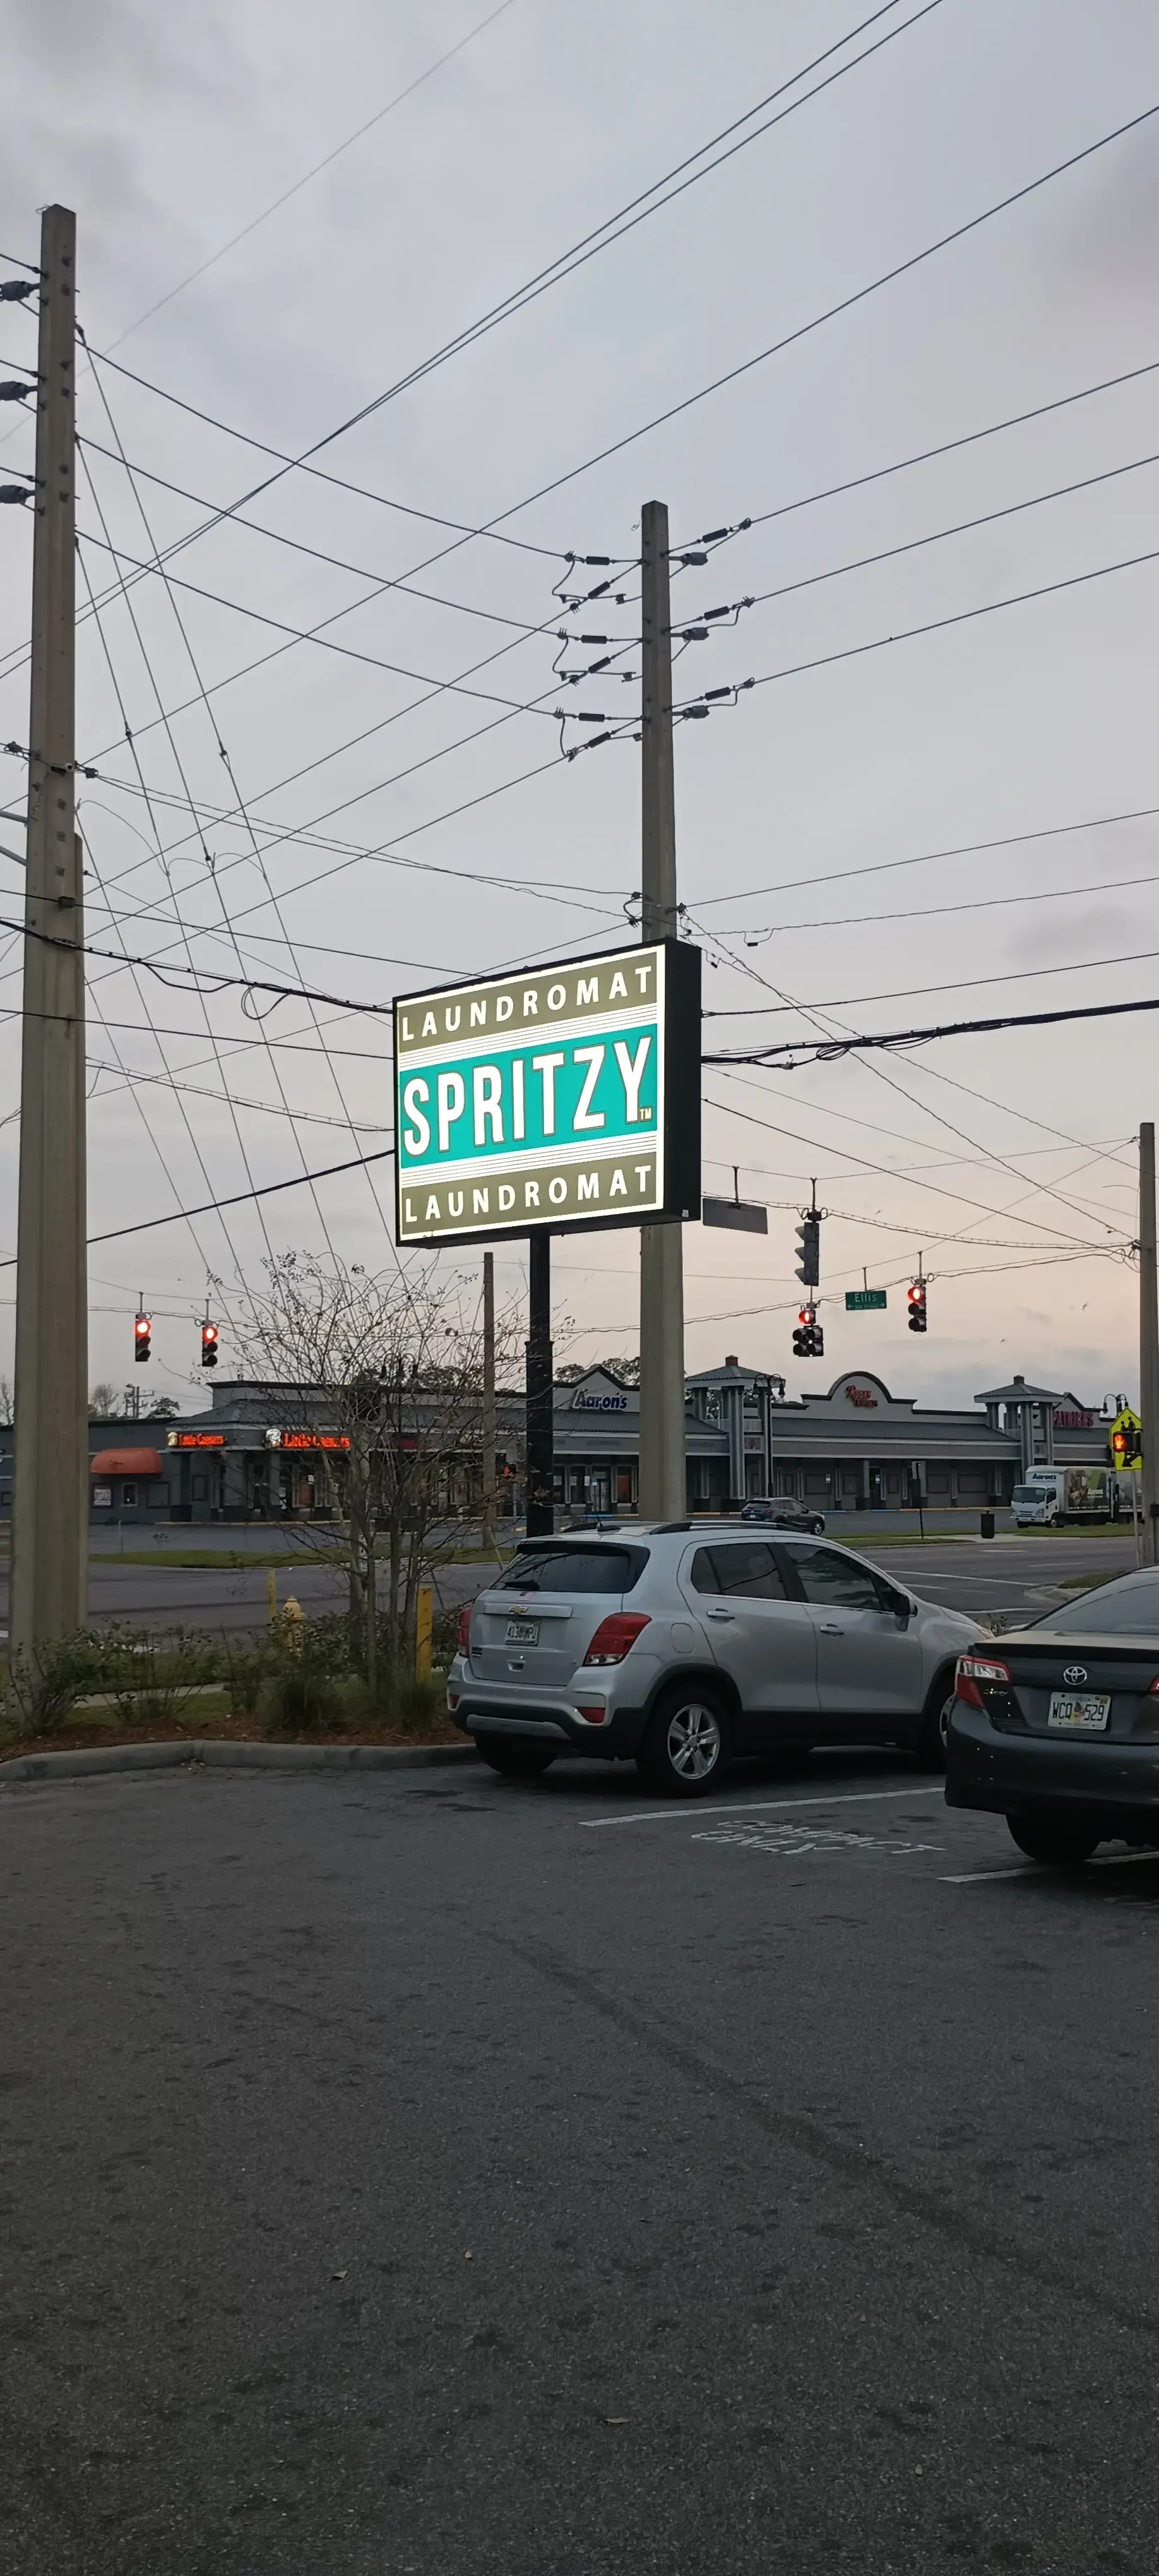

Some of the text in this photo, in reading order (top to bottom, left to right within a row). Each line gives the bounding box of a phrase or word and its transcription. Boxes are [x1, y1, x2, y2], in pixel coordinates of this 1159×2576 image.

[401, 965, 651, 1041] LAUNDROMAT
[402, 1035, 653, 1158] SPRITZY
[405, 1165, 651, 1223] LAUNDROMAT
[854, 1292, 877, 1303] Ellis
[572, 1388, 627, 1411] Aaron's
[1084, 1704, 1105, 1721] 529
